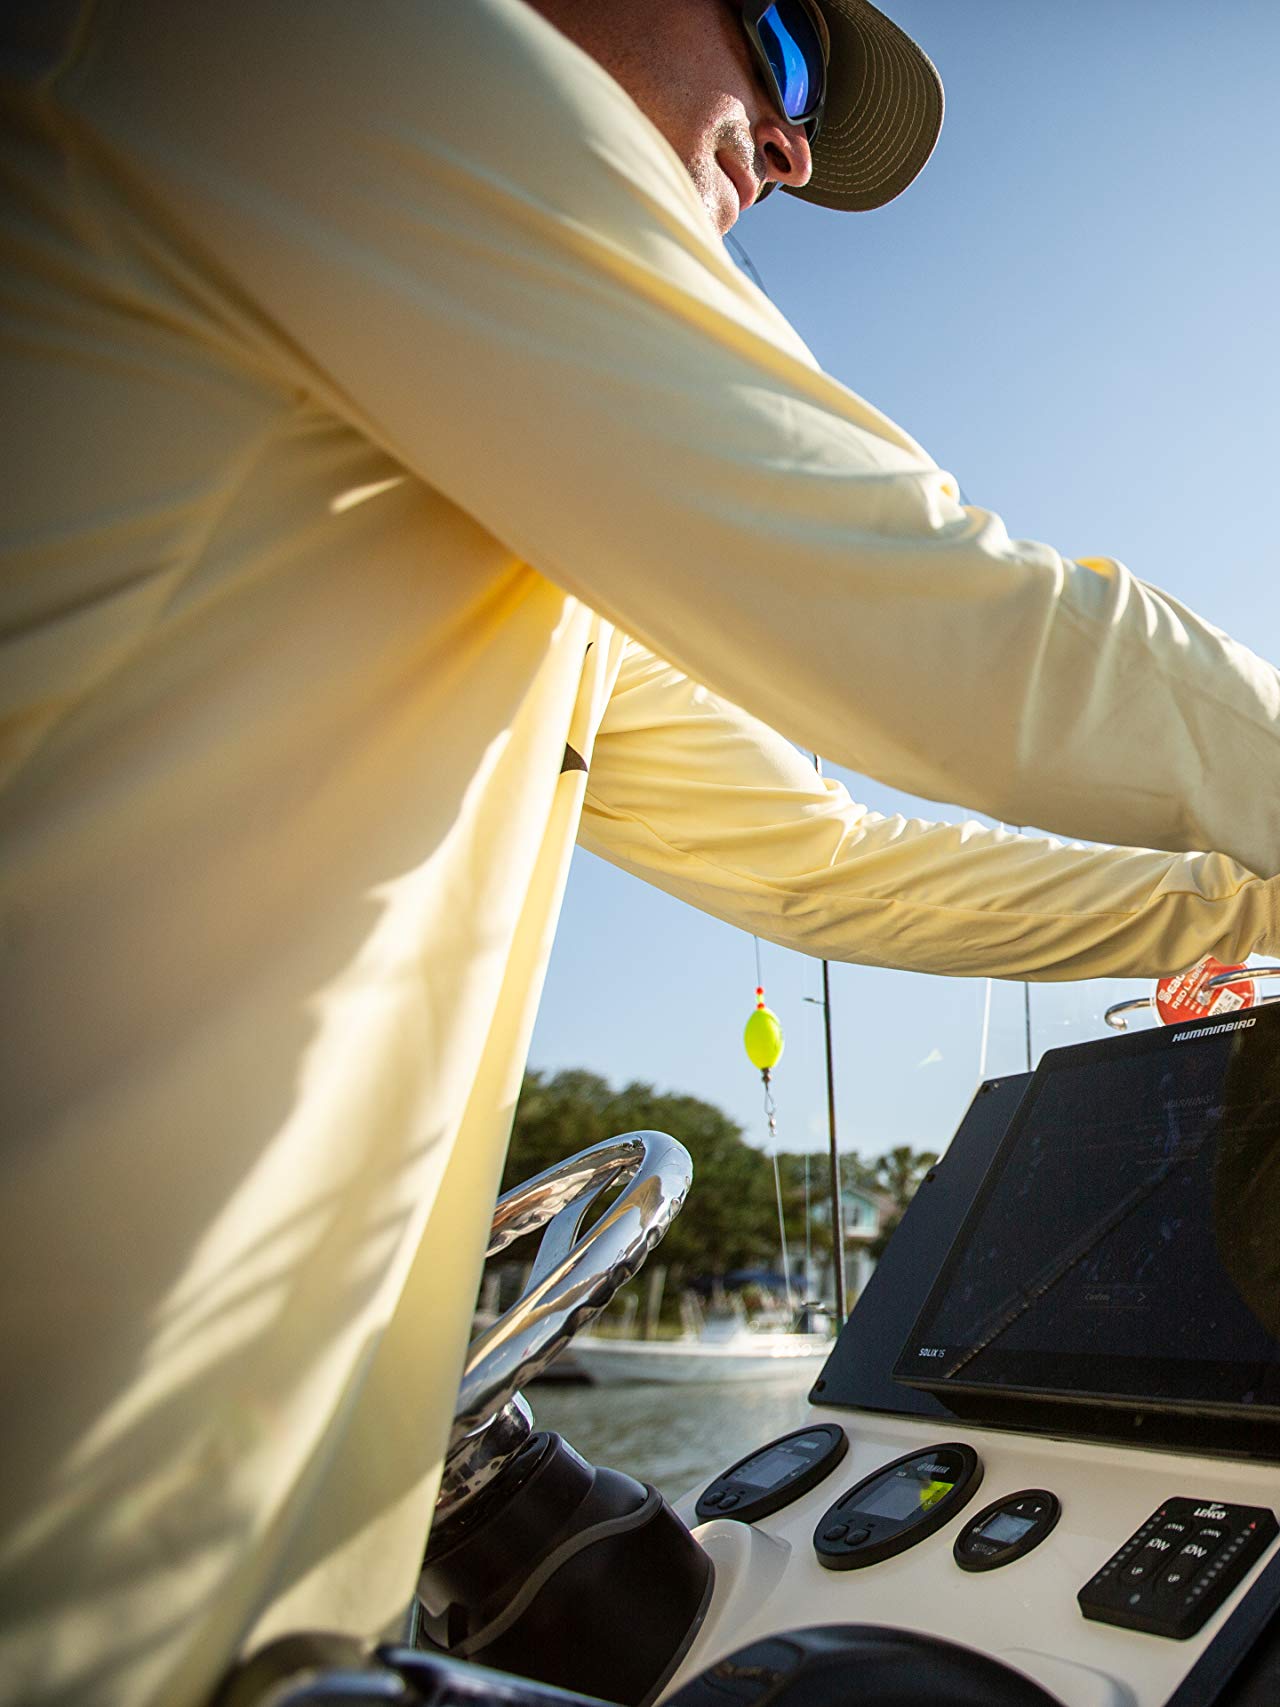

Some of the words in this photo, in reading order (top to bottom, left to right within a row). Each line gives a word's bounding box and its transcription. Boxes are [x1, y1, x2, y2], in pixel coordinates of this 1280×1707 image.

[1171, 990, 1187, 1010] RED
[1172, 1018, 1257, 1042] HUMMINBIRD
[1194, 1504, 1227, 1520] LENCO
